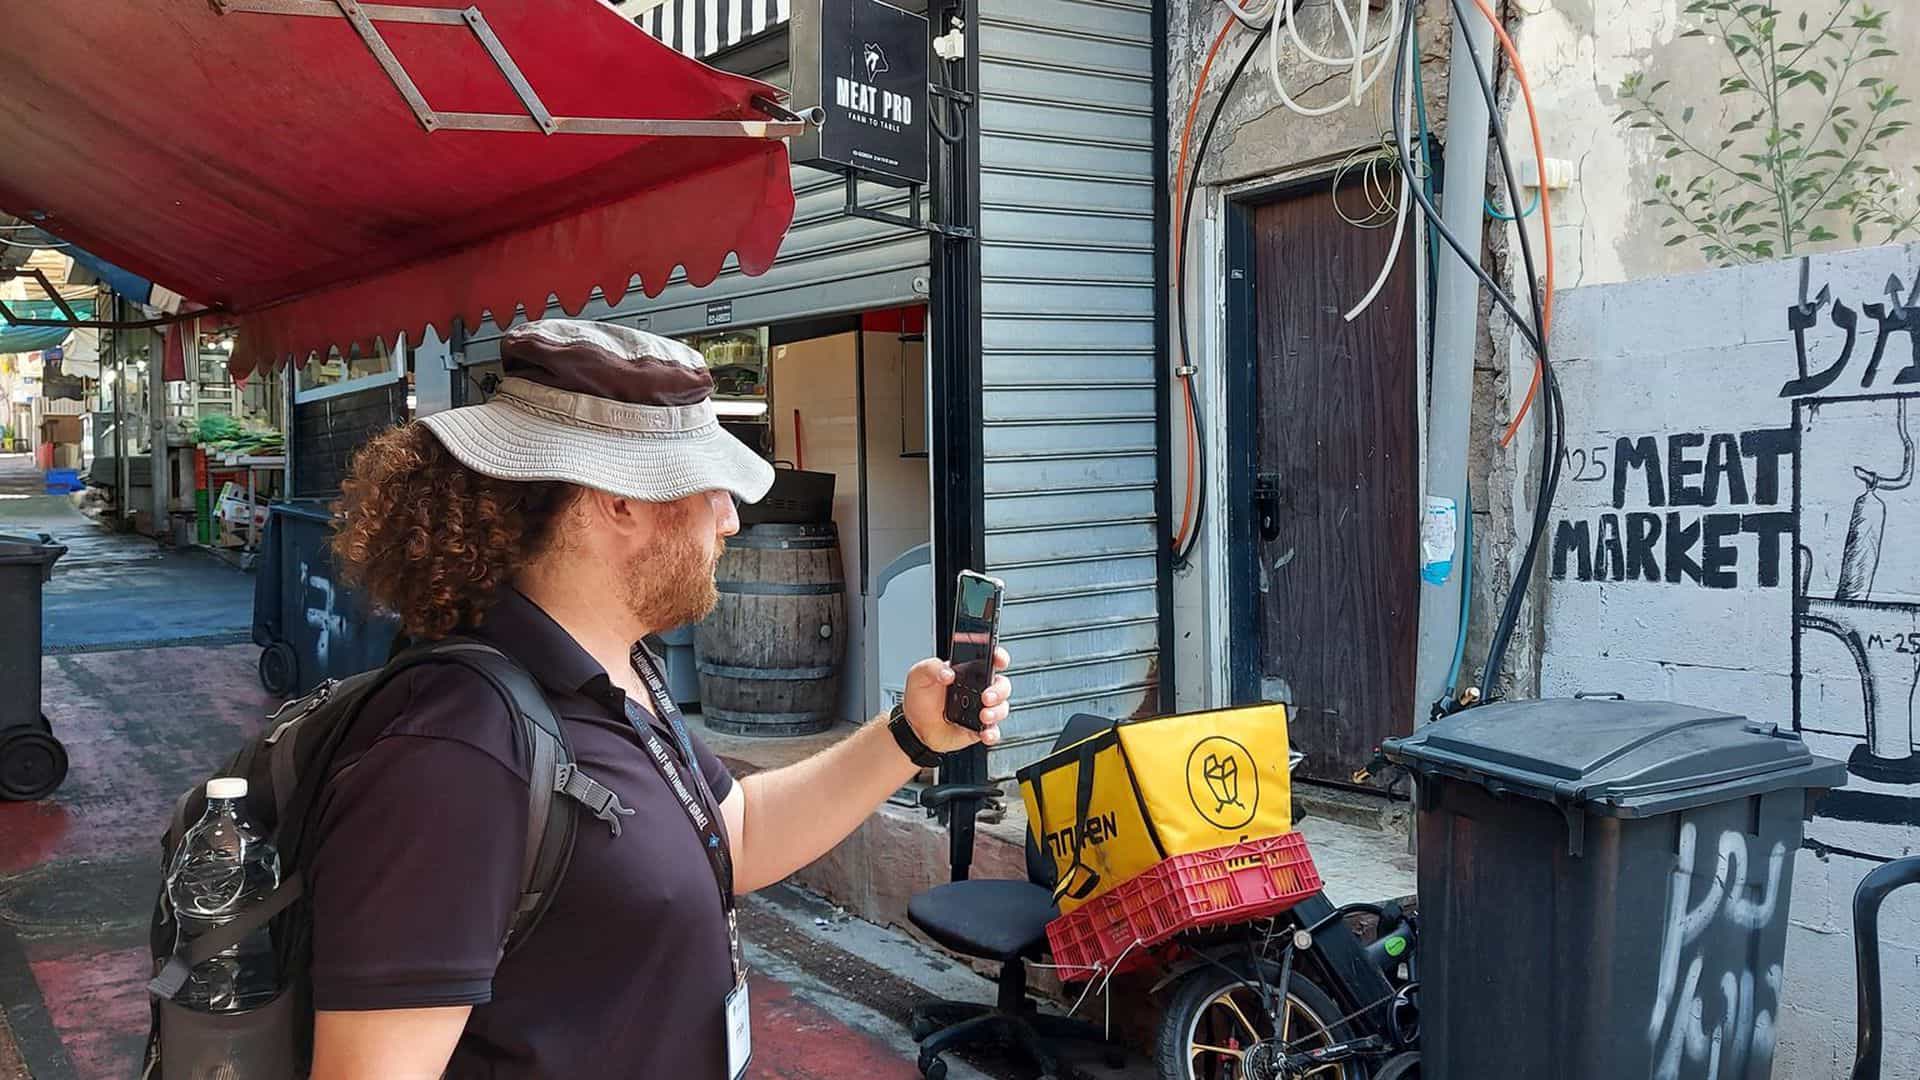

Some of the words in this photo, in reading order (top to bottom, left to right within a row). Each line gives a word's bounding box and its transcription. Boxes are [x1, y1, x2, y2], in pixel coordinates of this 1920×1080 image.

[836, 76, 877, 115] MEAT
[883, 90, 912, 125] PRO
[848, 112, 867, 124] FARM
[869, 118, 879, 127] TO
[880, 121, 900, 133] TABLE
[1612, 429, 1793, 509] MEAT
[1551, 511, 1793, 589] MARKET
[687, 800, 710, 832] ISRAEL
